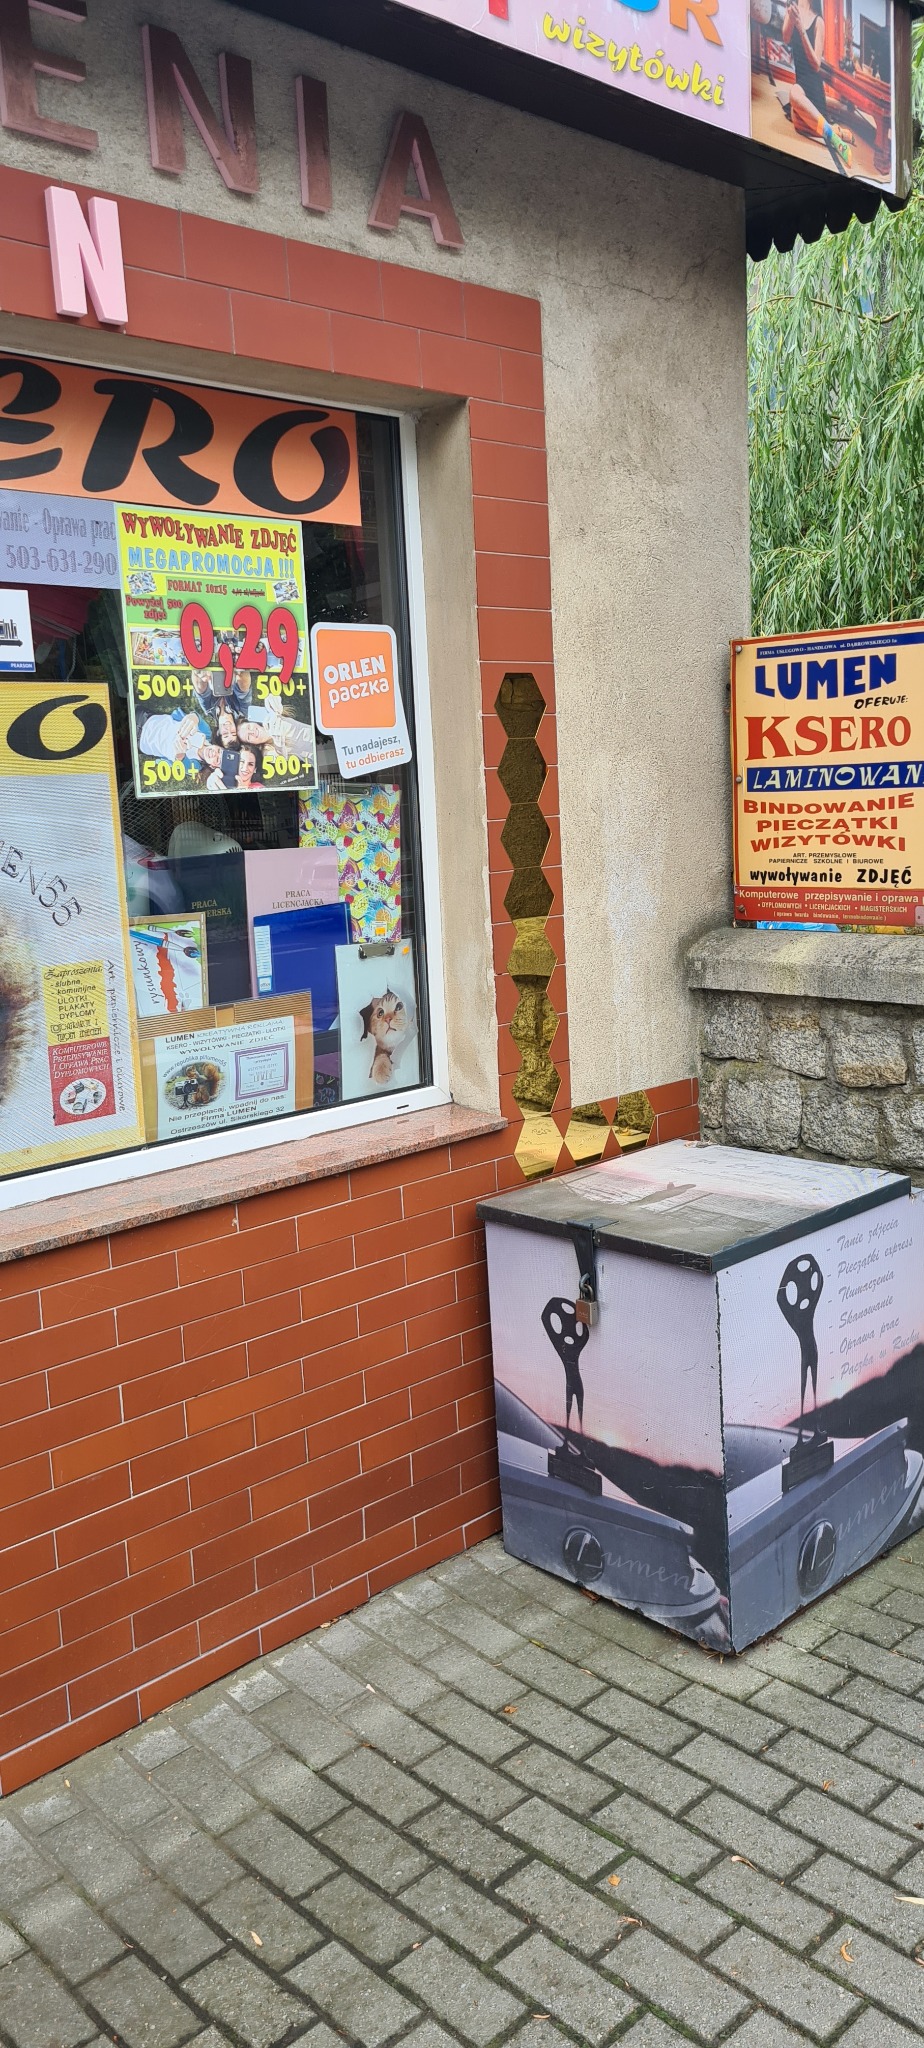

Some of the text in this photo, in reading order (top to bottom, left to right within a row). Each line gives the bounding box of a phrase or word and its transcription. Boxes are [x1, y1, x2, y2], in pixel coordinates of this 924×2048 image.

[542, 12, 726, 106] wizytówki
[44, 185, 129, 327] N
[42, 507, 87, 543] Oprawa
[121, 512, 297, 557] WYWOŁYWANIE ZDJĘĆ
[6, 544, 118, 577] 503-631-290
[128, 546, 294, 579] MEGAPROMOCJA !!!
[167, 579, 202, 593] FORMAT
[125, 595, 183, 609] Powyżej 500
[180, 602, 298, 688] 0,29
[323, 654, 386, 685] ORLEN
[754, 652, 897, 700] LUMEN
[137, 674, 307, 701] 500+ 500+
[328, 677, 390, 709] paczka
[854, 695, 909, 710] OFERUJE:
[342, 735, 401, 757] Tu nadajesz,
[744, 715, 912, 761] KSERO
[142, 760, 200, 786] 500+
[262, 754, 312, 779] 500+
[345, 747, 406, 770] tu odbierasz
[752, 763, 924, 791] LAMINOWAN
[743, 792, 915, 815] BINDOWANIE
[757, 816, 898, 833] PIECZĄTKI
[750, 831, 906, 853] WIZYTÓWKI
[0, 840, 83, 927] EN55
[750, 866, 912, 888] wywoływanie ZDJĘĆ
[191, 898, 218, 910] PRACA
[272, 898, 325, 910] LICENCJACKA
[285, 889, 311, 898] PRACA
[739, 889, 799, 900] Komputerowe
[804, 892, 872, 902] przepisywanie
[875, 892, 879, 902] i
[881, 895, 919, 904] oprawa
[761, 902, 908, 913] DYPLOMOWYCH LICENCJACKICH MAGISTERSKICH
[133, 940, 165, 1005] rysunkowy
[57, 985, 97, 996] komunijne
[57, 995, 88, 1005] ULOTKI
[58, 1001, 95, 1012] PLAKATY
[59, 1008, 97, 1020] DYPLOMY
[107, 960, 116, 985] Art.
[117, 1066, 126, 1111] biurowe
[165, 1032, 195, 1044] LUMEN
[168, 1114, 183, 1123] Nie
[228, 1100, 258, 1110] wpadnij
[170, 1121, 217, 1135] Ostrzeszów
[230, 1109, 274, 1122] Sikorskiego
[201, 1105, 257, 1122] Firma LUMEN
[837, 1217, 900, 1252] Tanie zdjęcia
[837, 1237, 914, 1279] Pieczątki express
[838, 1294, 894, 1330] Skanowanie
[839, 1316, 900, 1355] Oprawa prac
[840, 1328, 921, 1380] Paczka w Ruchu
